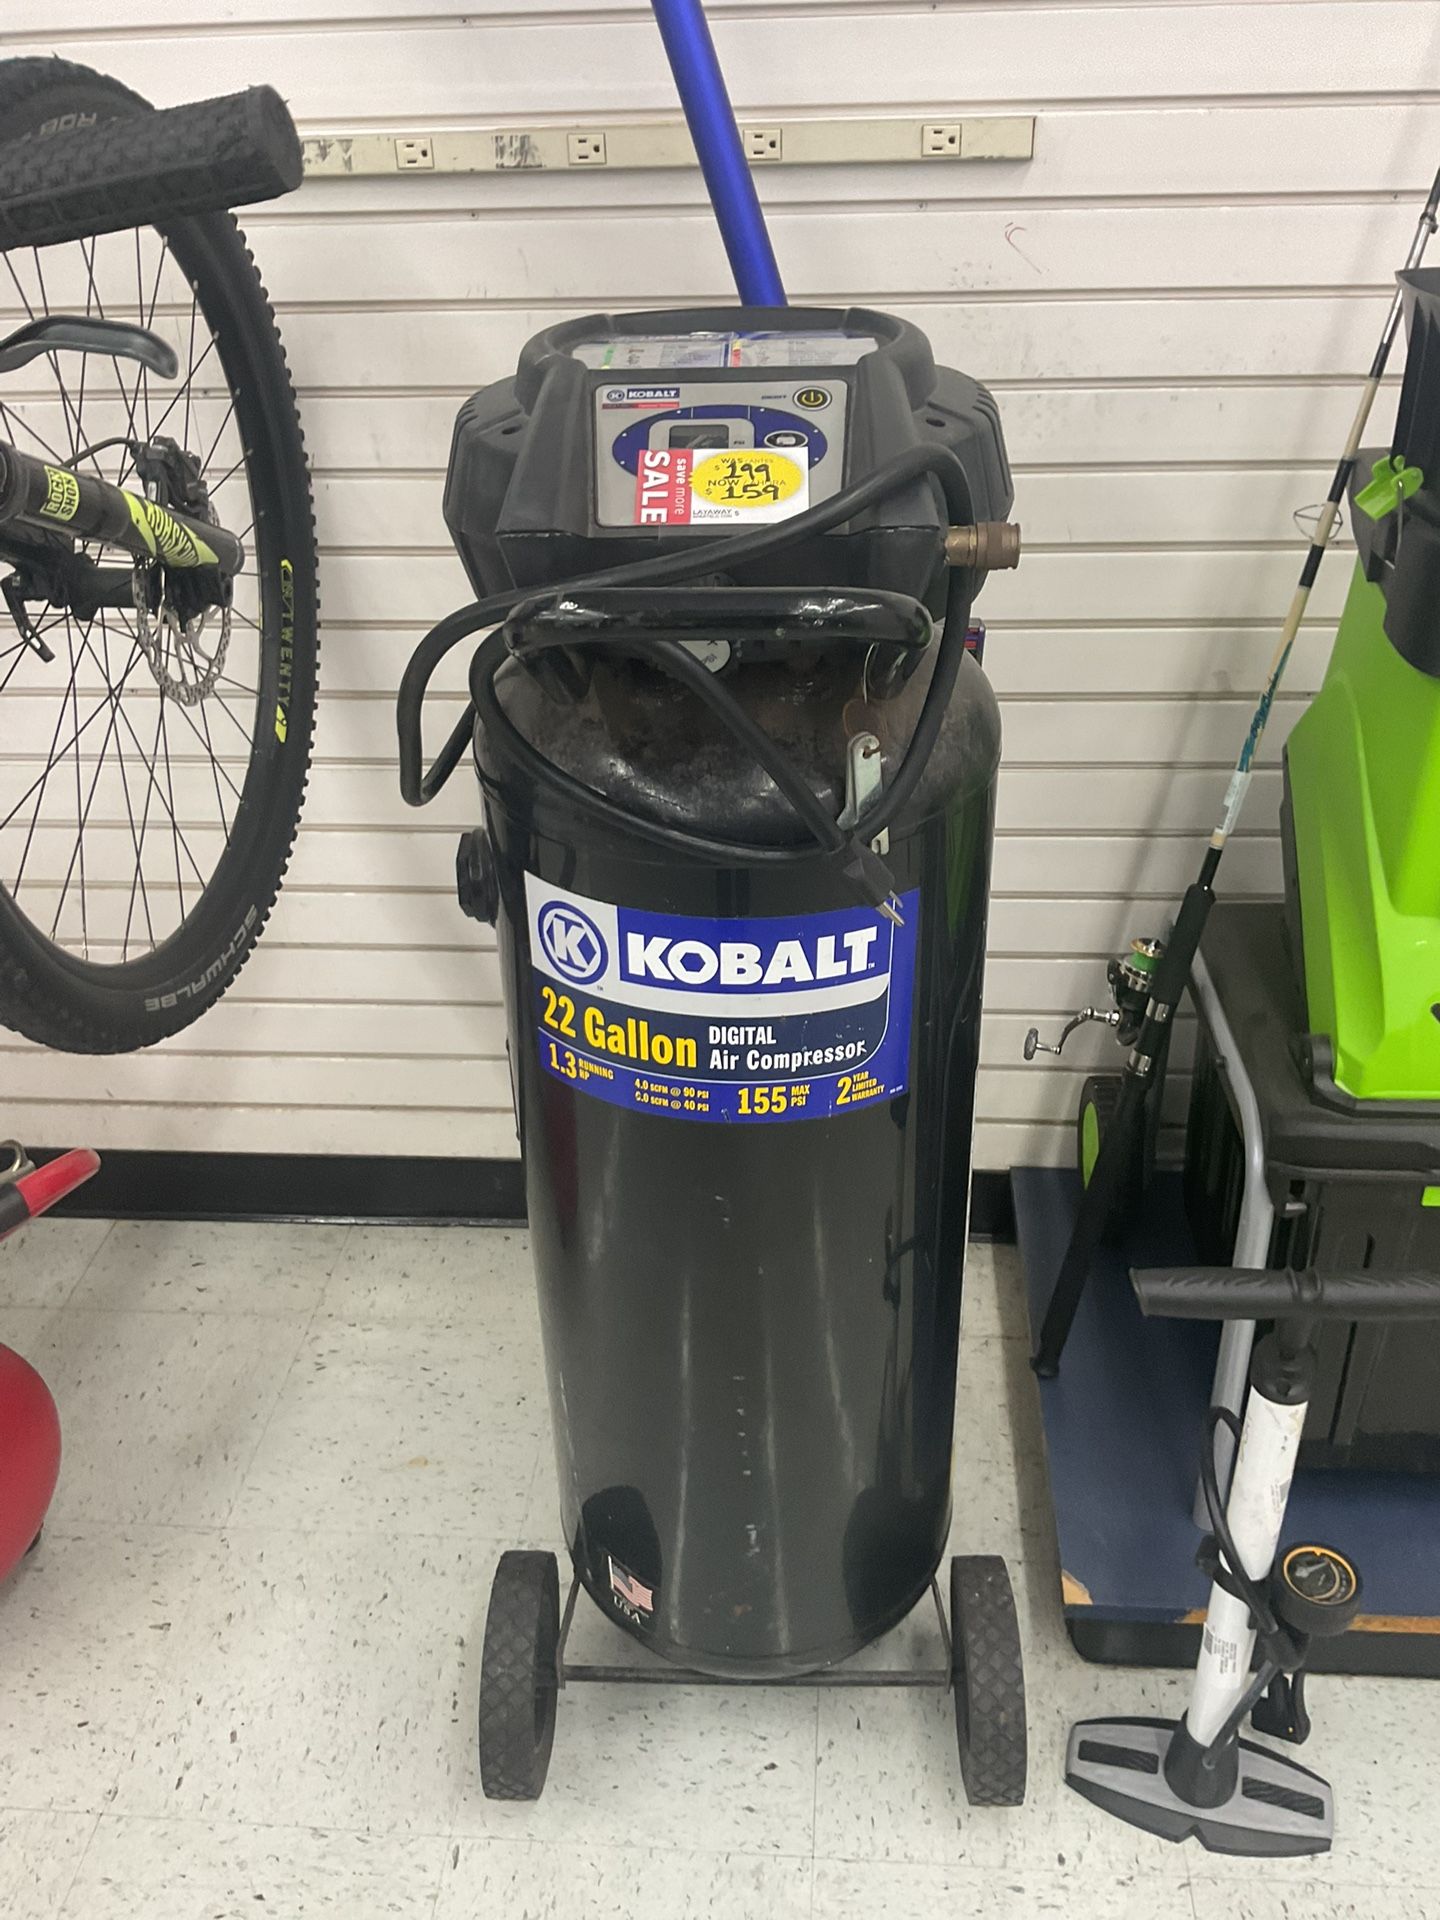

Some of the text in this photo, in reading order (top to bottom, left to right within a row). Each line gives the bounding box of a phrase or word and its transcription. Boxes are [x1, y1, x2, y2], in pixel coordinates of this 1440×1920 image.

[628, 390, 678, 399] KOBALT
[641, 451, 670, 523] SALE
[674, 458, 687, 515] save more
[723, 461, 771, 482] 199
[47, 469, 64, 514] ROCK
[60, 476, 79, 516] SHOX
[720, 484, 780, 500] 159
[144, 904, 258, 1012] SCHWALBE
[627, 926, 877, 985] KOBALT
[542, 986, 698, 1068] 22 Gallon
[708, 1025, 777, 1046] DIGITAL
[549, 1043, 614, 1080] 1.3 RUNNING
[709, 1040, 868, 1073] Air Compressor
[634, 1078, 710, 1100] 4.0 SCFM @ 90 PSI
[738, 1083, 811, 1115] 155 MAX
[836, 1070, 869, 1105] 2 YEAR
[851, 1084, 885, 1102] WARRANTY
[852, 1078, 877, 1092] LIMITED
[650, 1096, 669, 1107] SCFM
[670, 1099, 682, 1110] @
[683, 1099, 696, 1111] 40
[697, 1102, 710, 1112] PSI
[790, 1096, 807, 1107] PSI
[614, 1595, 641, 1624] USA
